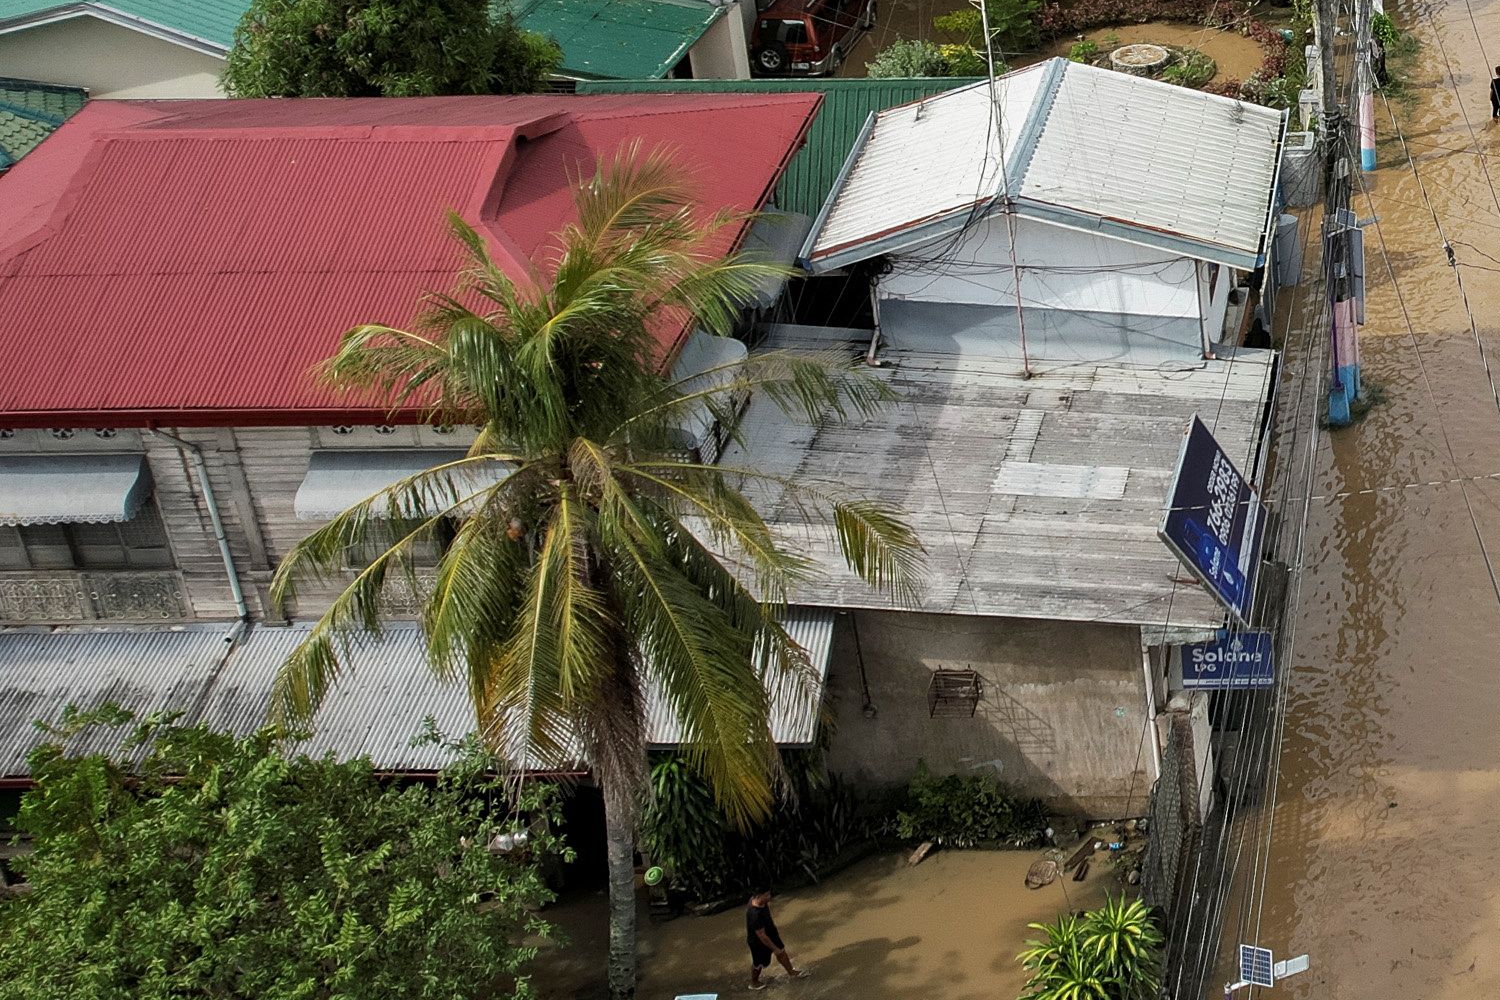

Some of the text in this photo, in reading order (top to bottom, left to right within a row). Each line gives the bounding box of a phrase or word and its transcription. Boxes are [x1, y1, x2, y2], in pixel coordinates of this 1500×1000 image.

[1206, 458, 1232, 536] 766-2983
[1192, 647, 1262, 663] Solane
[1194, 663, 1217, 672] LPG
